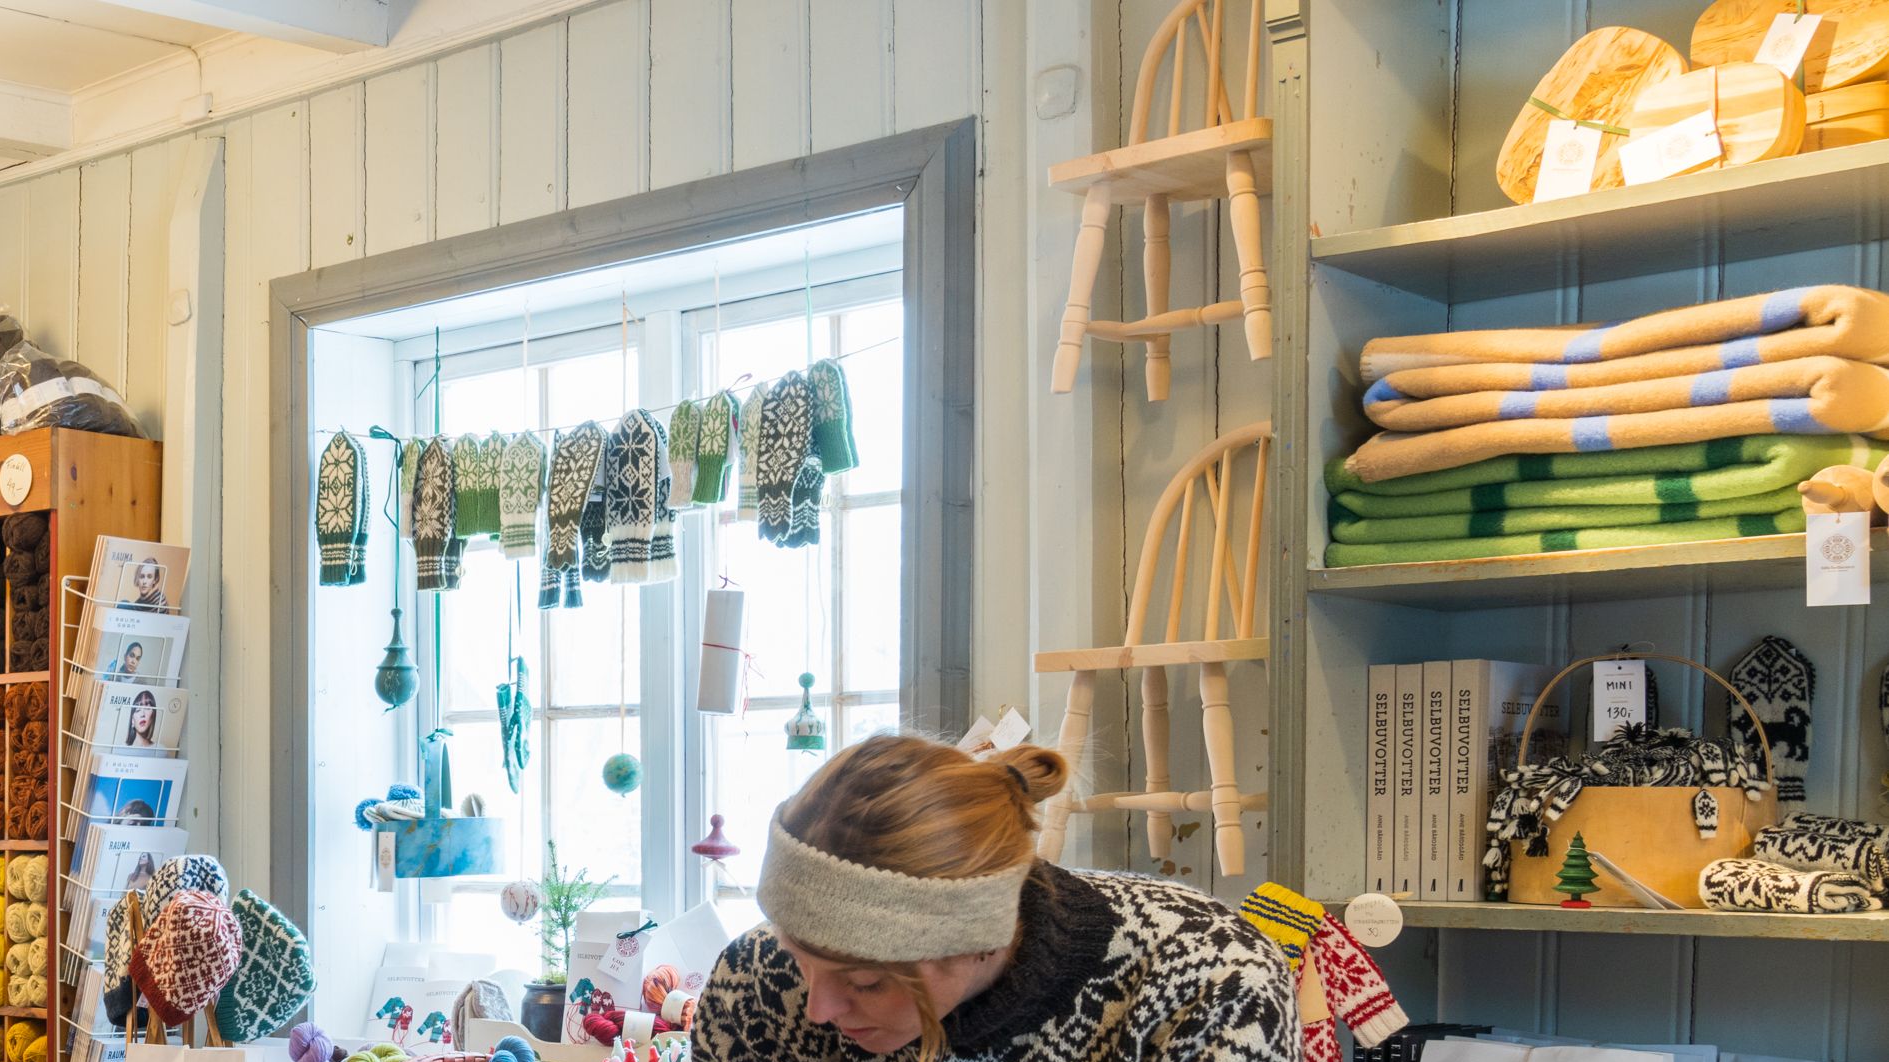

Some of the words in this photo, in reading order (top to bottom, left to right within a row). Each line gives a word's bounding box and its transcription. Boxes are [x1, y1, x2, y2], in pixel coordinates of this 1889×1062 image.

[111, 552, 133, 562] RAUMA
[1606, 680, 1632, 691] MINI
[110, 695, 131, 705] RAUMA
[1501, 702, 1560, 717] SELBUVTTER
[1375, 693, 1387, 796] SELBUVOTTER
[1401, 693, 1413, 796] SELBUVOTTER
[1429, 691, 1442, 795] SELBUVOTTER
[1457, 690, 1470, 795] SELBUVOTTER
[109, 841, 131, 850] RAUMA
